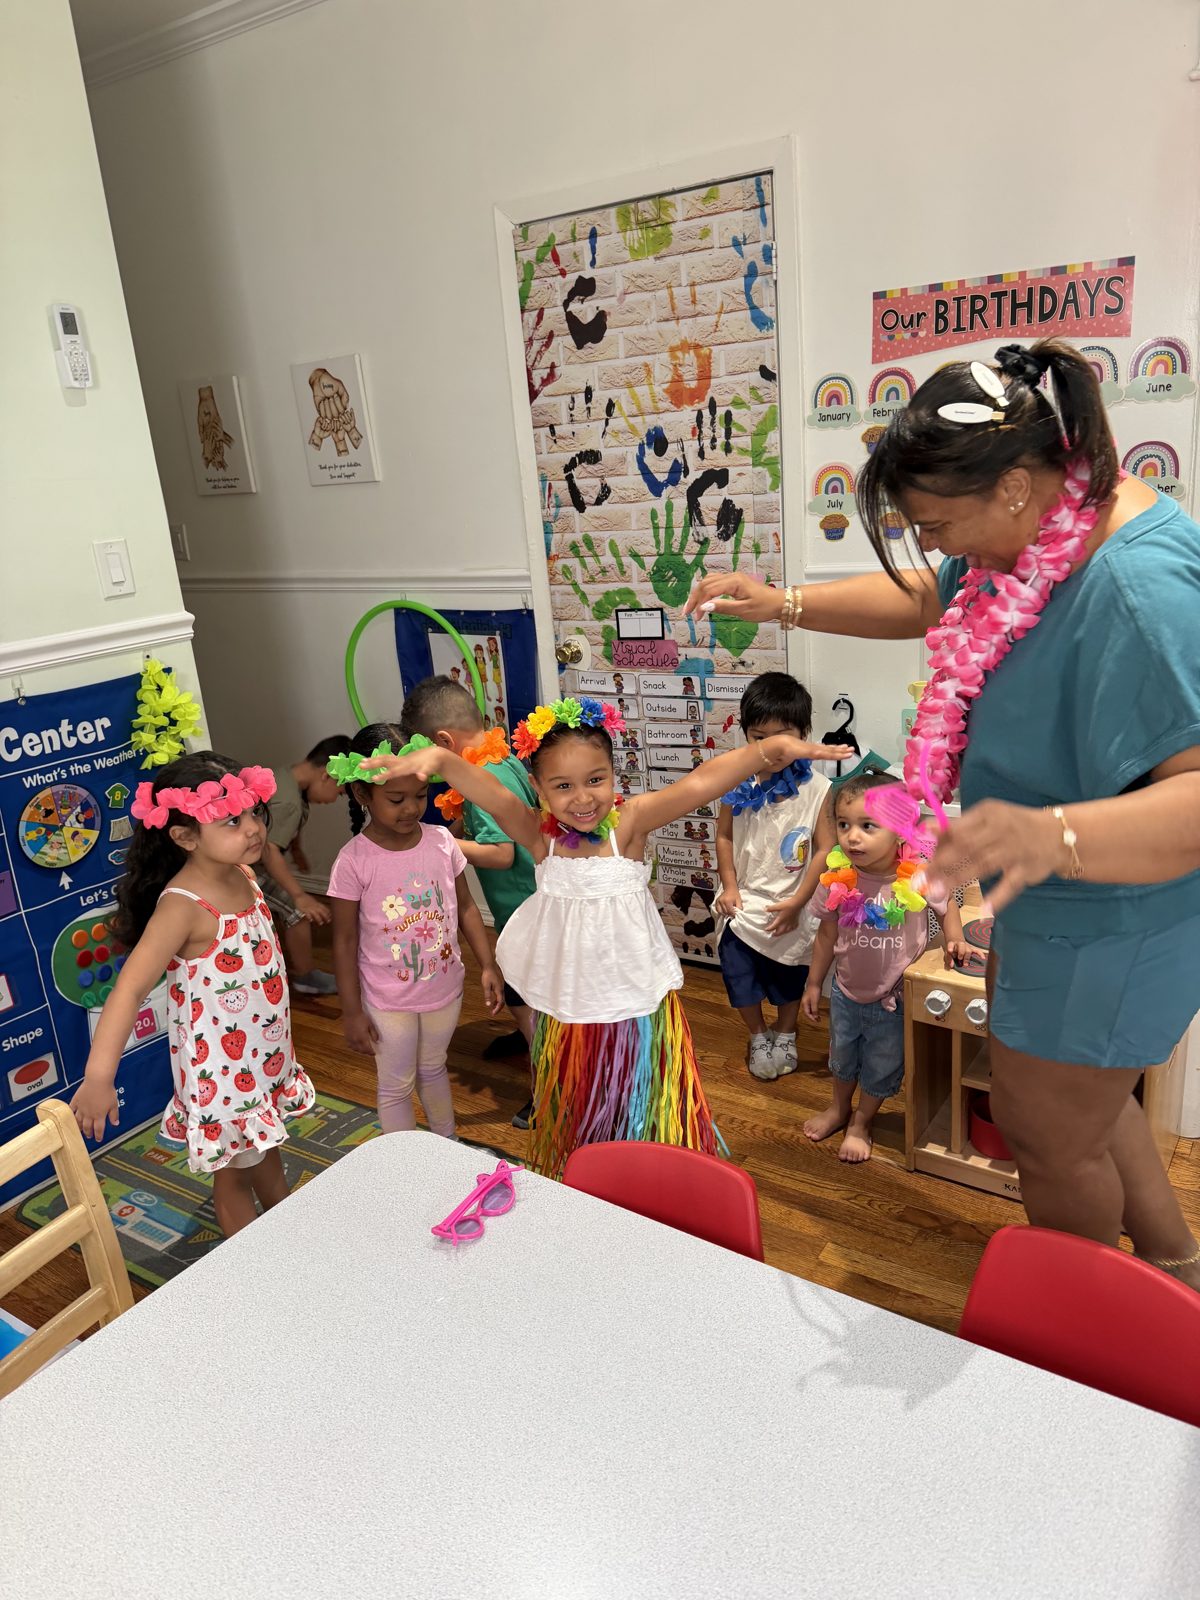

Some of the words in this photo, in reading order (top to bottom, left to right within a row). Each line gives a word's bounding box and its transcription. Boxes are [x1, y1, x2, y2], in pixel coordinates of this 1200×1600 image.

[881, 309, 927, 331] Our
[934, 276, 1125, 335] BIRTHDAYS
[1146, 382, 1172, 393] June
[818, 412, 851, 422] January
[827, 500, 843, 510] July
[612, 641, 657, 654] Visual
[613, 653, 679, 667] Schedule
[580, 676, 606, 686] Arrival
[643, 680, 667, 690] Snack
[707, 684, 747, 694] Dismissal
[646, 704, 677, 713] Outside
[647, 729, 688, 739] Bathroom
[0, 717, 111, 762] Center
[656, 752, 680, 762] Lunch
[22, 767, 68, 789] What's
[70, 763, 92, 776] the
[660, 775, 675, 785] Nap
[662, 828, 679, 838] Play
[662, 847, 685, 857] Music
[688, 849, 693, 857] &
[658, 854, 698, 866] Movement
[662, 866, 686, 876] Whole
[662, 874, 686, 885] Group
[80, 889, 108, 907] Let's
[851, 930, 903, 950] Jeans
[2, 1027, 43, 1051] Shape
[27, 1079, 43, 1091] oval
